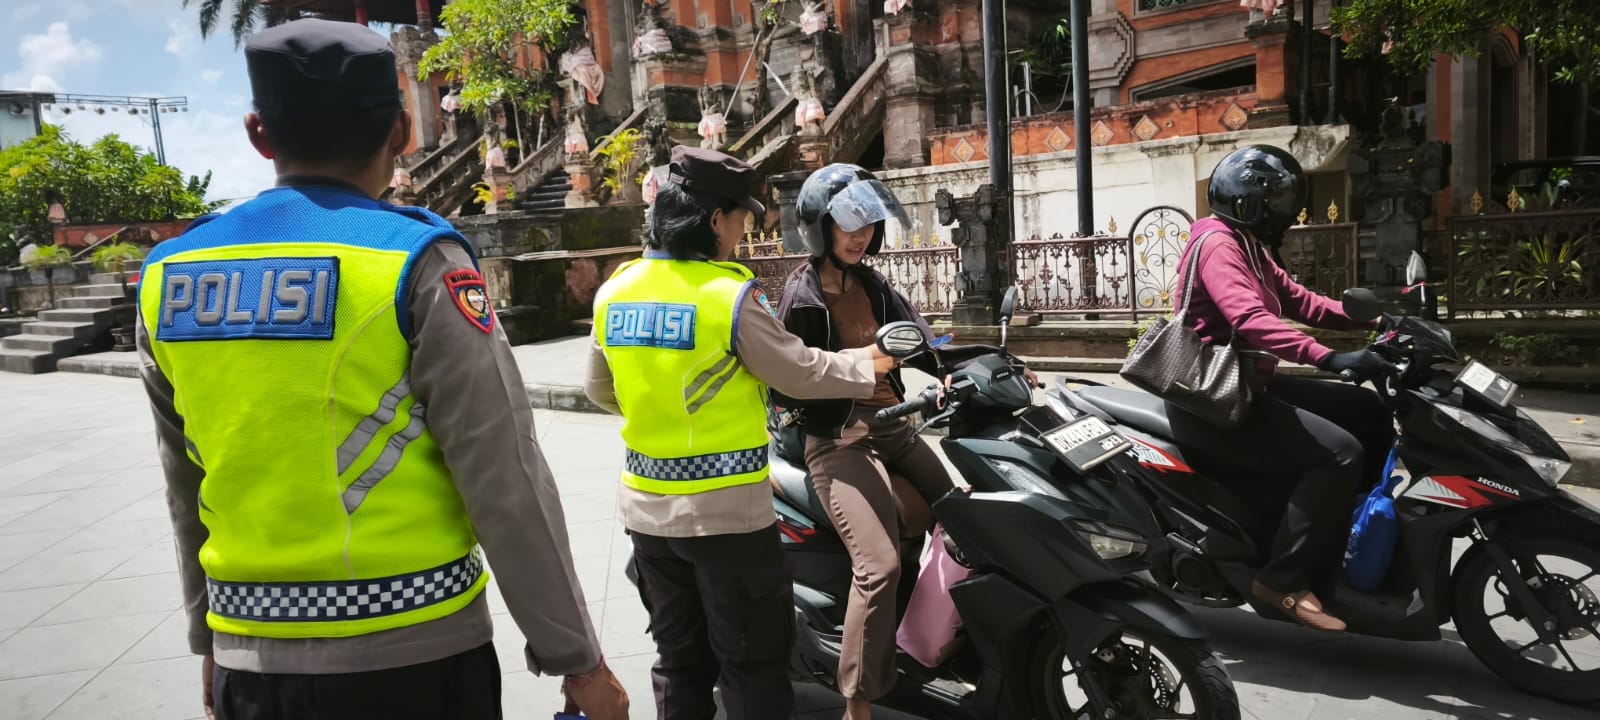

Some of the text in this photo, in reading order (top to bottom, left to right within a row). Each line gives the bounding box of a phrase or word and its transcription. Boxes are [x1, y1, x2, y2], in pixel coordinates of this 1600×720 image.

[163, 269, 329, 326] POLISI
[606, 308, 691, 342] POLISI
[1477, 476, 1520, 496] HONDA
